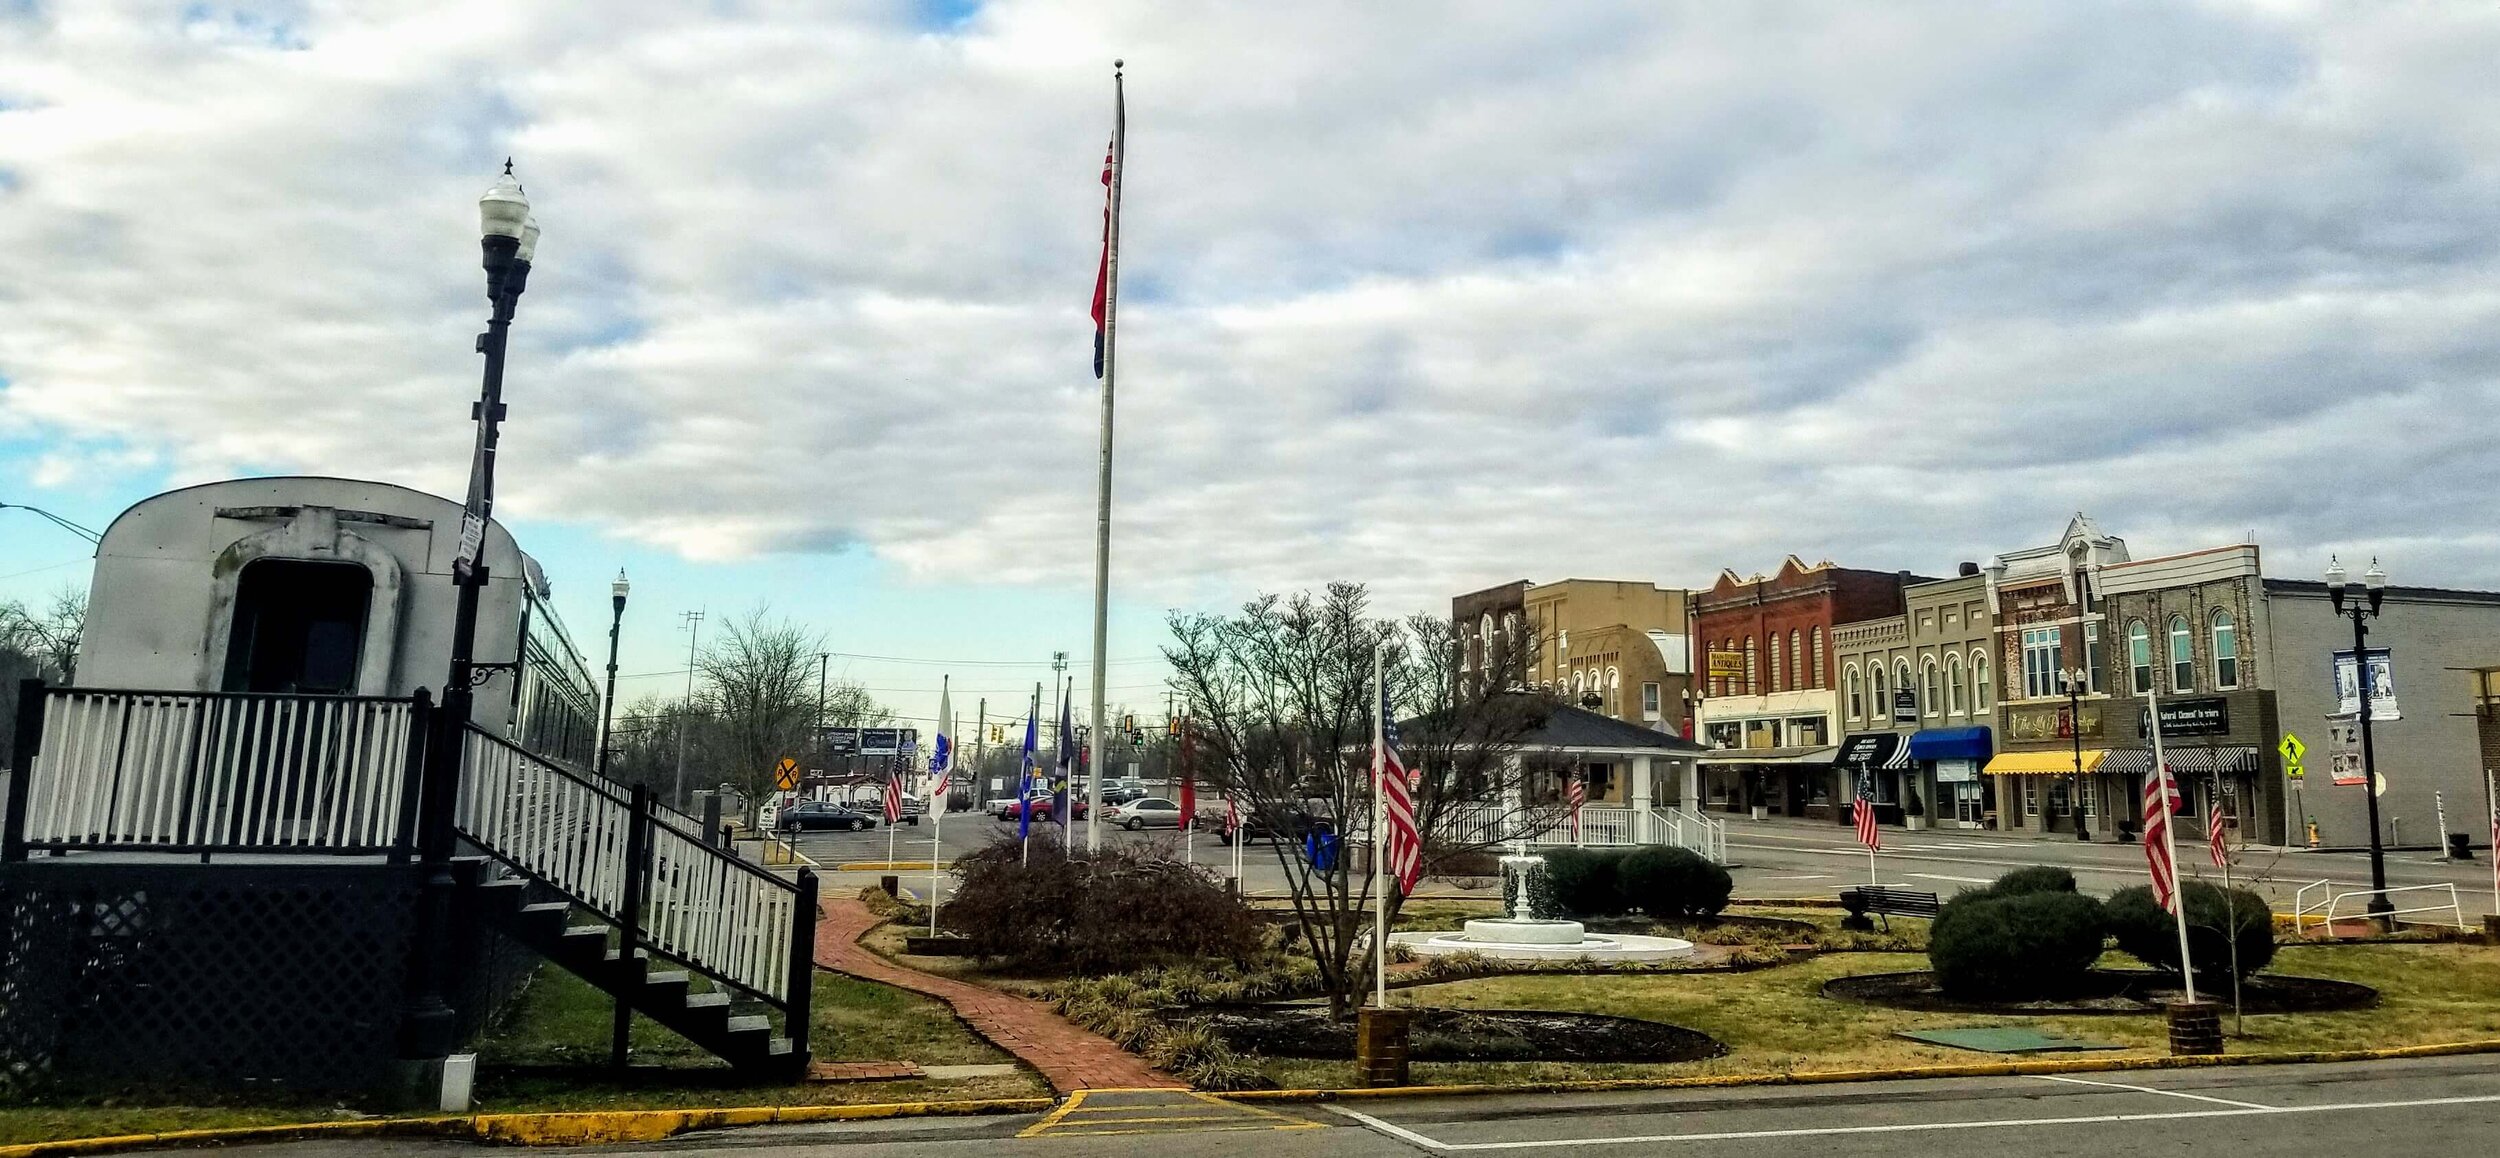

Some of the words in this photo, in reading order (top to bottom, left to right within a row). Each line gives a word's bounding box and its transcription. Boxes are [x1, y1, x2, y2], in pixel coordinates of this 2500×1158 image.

[1712, 659, 1742, 668] ANTIQUES
[777, 769, 783, 777] R
[791, 770, 797, 779] R
